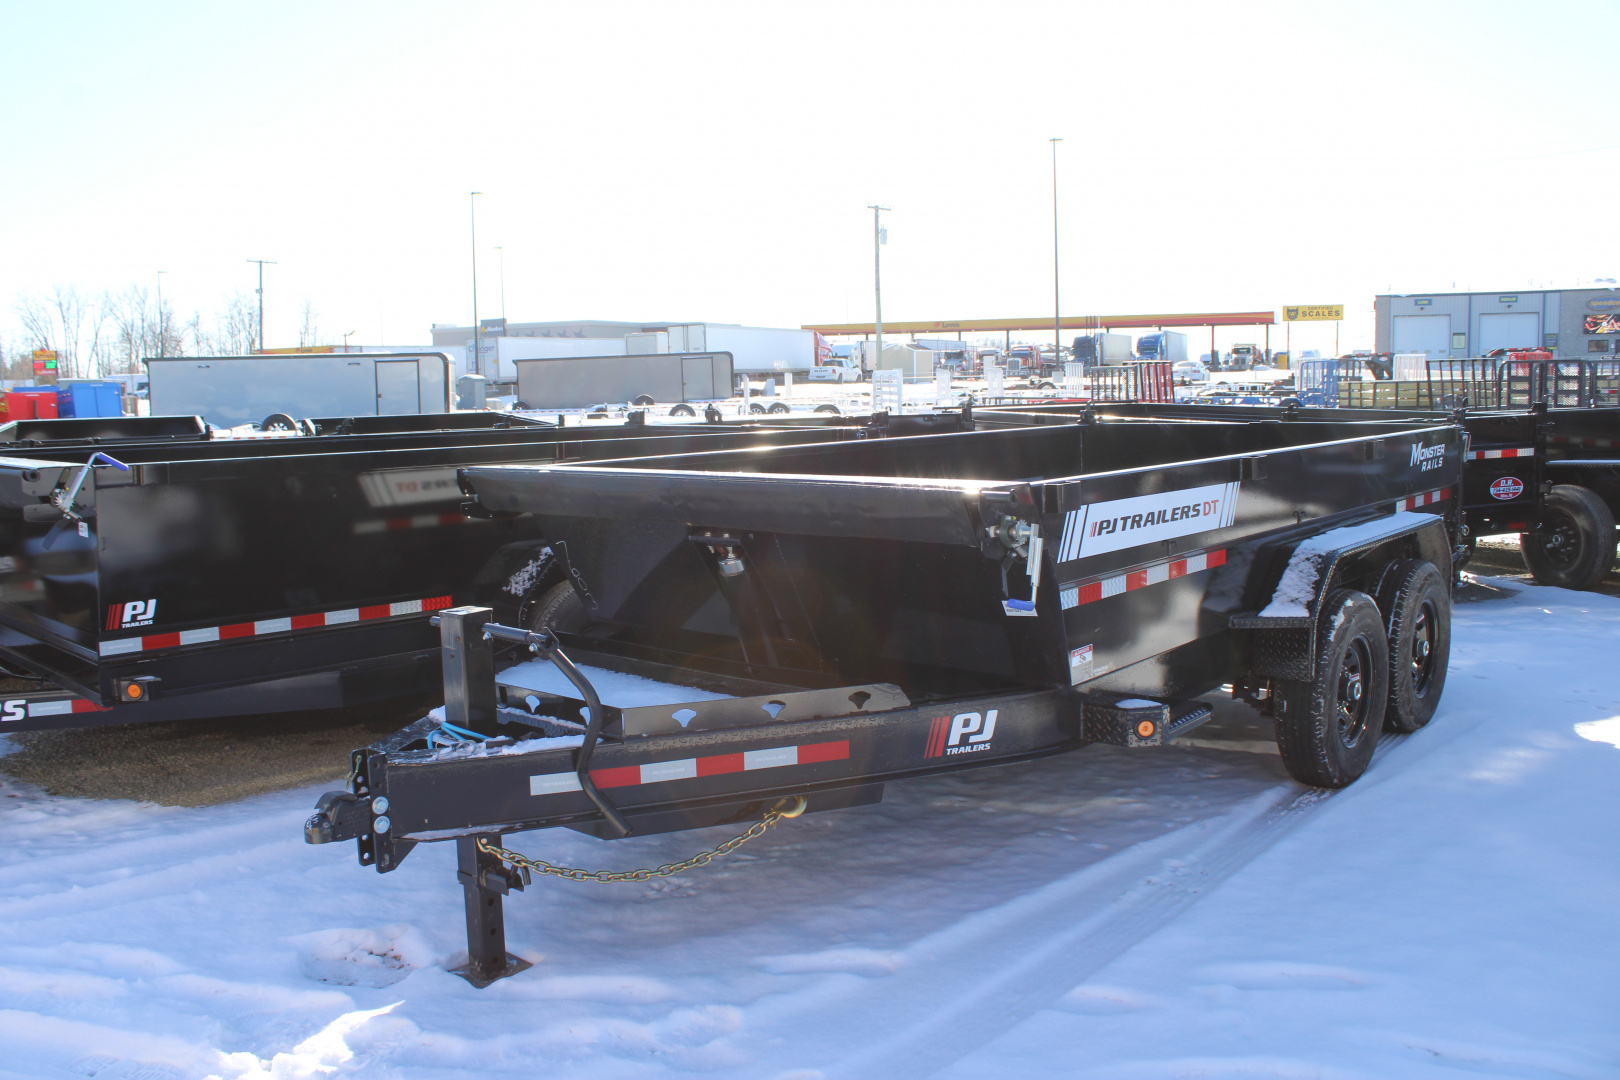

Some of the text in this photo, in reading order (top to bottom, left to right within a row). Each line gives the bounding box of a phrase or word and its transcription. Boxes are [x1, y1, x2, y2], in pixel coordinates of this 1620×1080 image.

[1302, 310, 1340, 318] SCALES
[1421, 456, 1444, 472] RAILS
[1500, 479, 1514, 487] D.R.
[1203, 499, 1220, 517] DT
[121, 598, 157, 622] PJ
[121, 619, 154, 629] TRAILERS
[948, 709, 999, 746] PJ
[946, 742, 992, 756] TRAILERS
